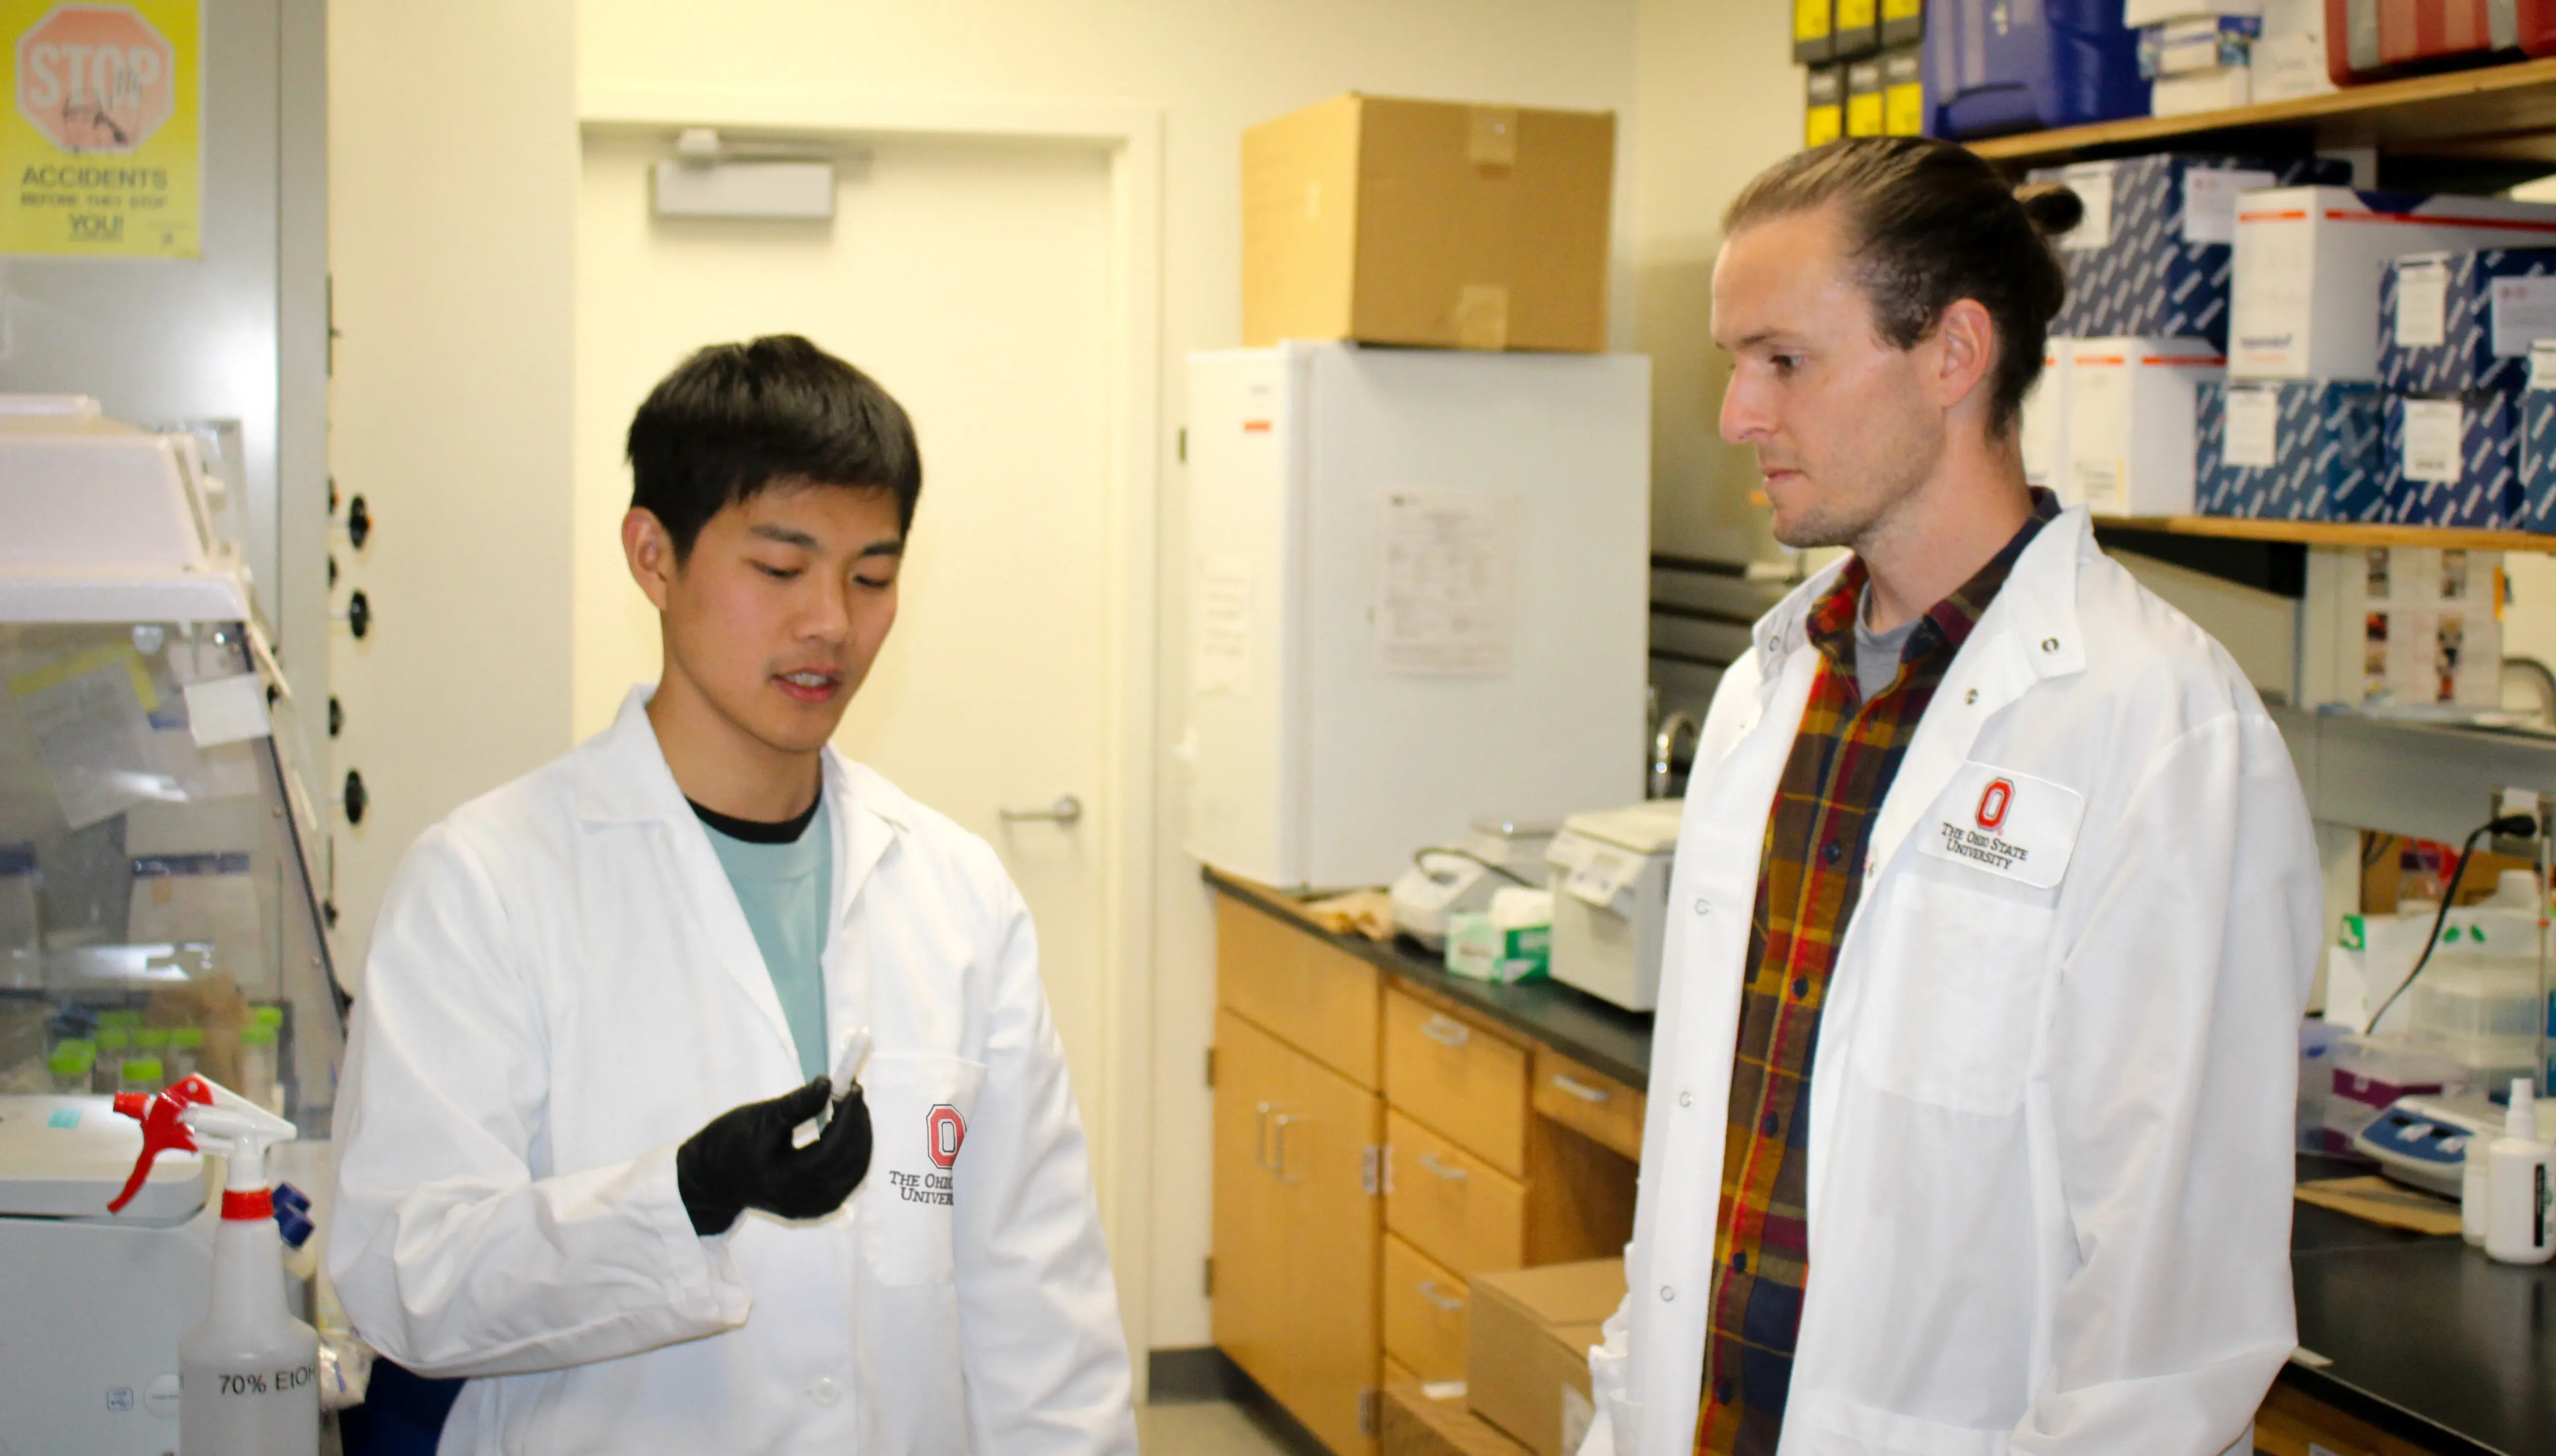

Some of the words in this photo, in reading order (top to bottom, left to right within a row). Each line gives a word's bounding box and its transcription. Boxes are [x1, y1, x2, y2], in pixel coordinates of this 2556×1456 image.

[31, 43, 160, 109] STOP
[21, 165, 168, 189] ACCIDENTS
[1942, 822, 1966, 839] THE
[1967, 830, 1989, 847] OHIO
[1990, 838, 2028, 861] STATE
[1946, 839, 2013, 870] UNIVERSITY
[889, 1171, 920, 1186] THE
[218, 1373, 267, 1395] 70%
